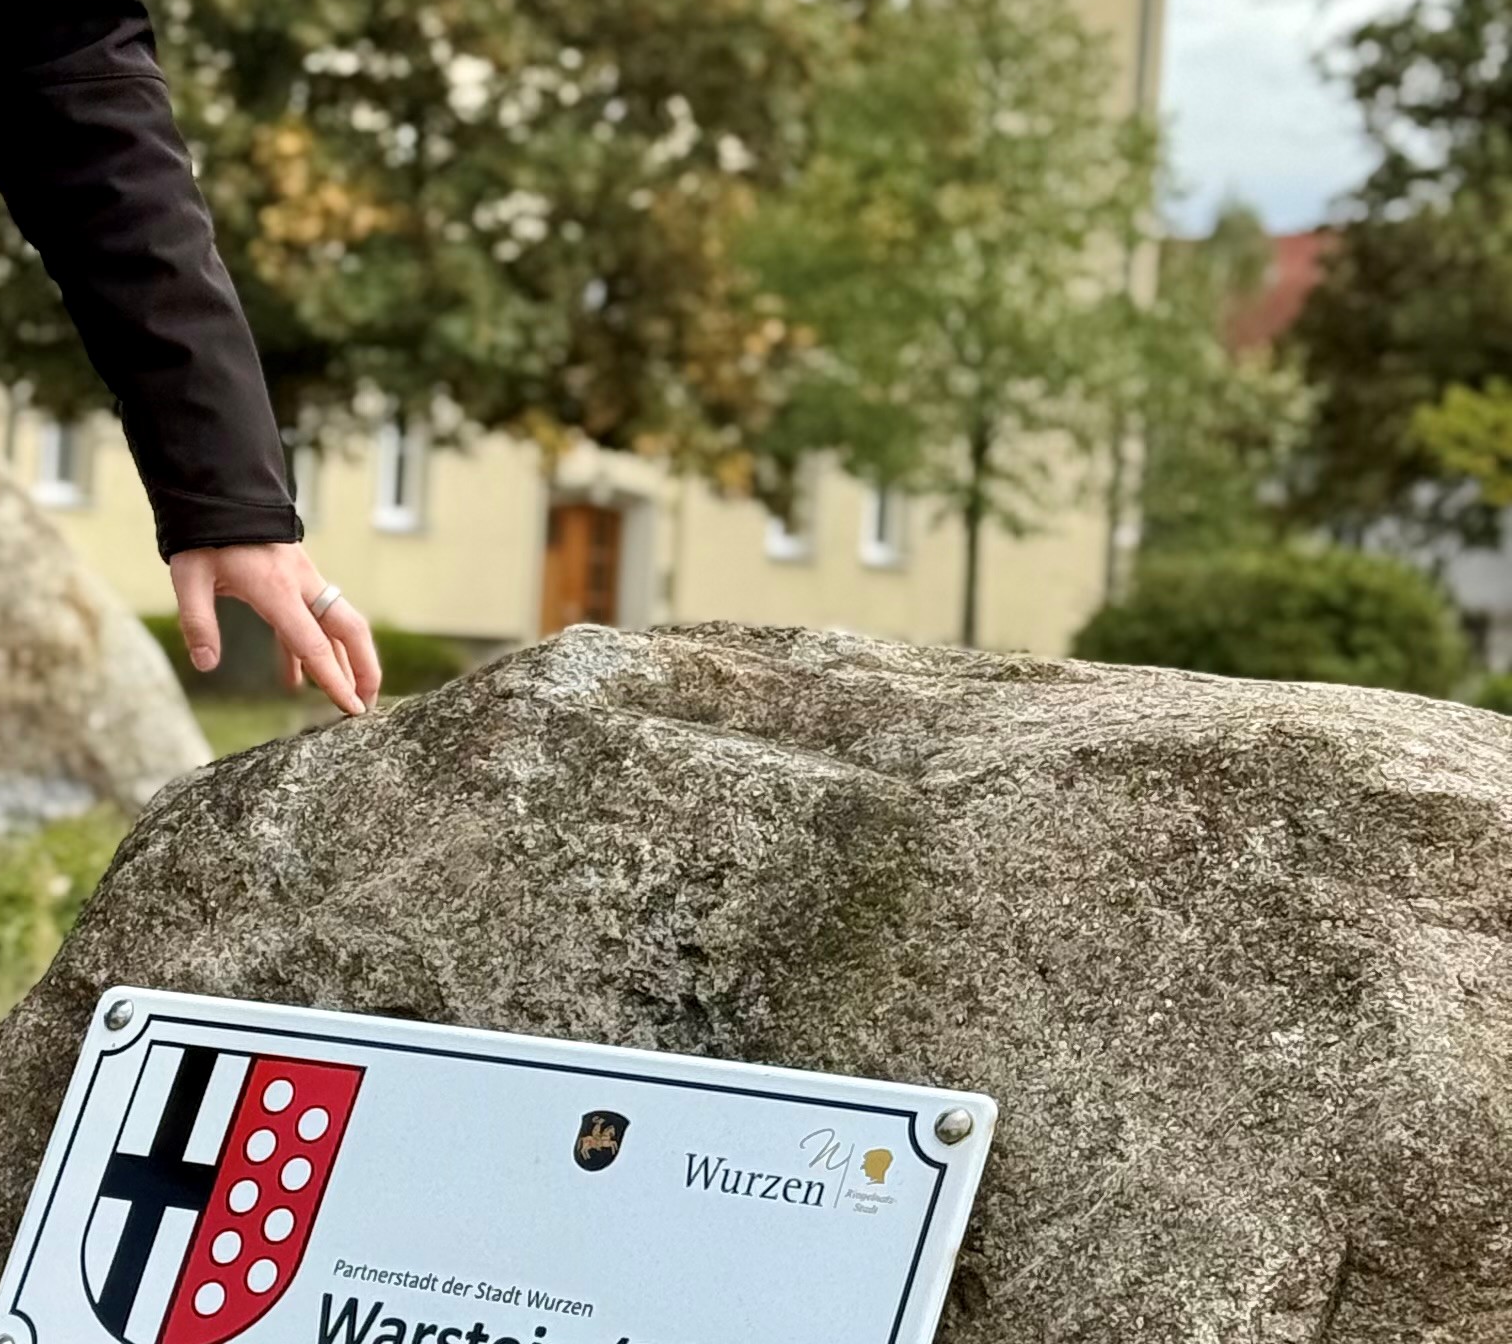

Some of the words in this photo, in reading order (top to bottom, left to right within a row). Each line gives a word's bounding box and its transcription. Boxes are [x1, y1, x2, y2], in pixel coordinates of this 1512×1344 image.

[684, 1152, 825, 1208] Wurzen
[333, 1259, 439, 1292] Partnerstadt
[441, 1276, 473, 1299] der
[474, 1282, 523, 1307] Stadt
[526, 1290, 594, 1318] Wurzen
